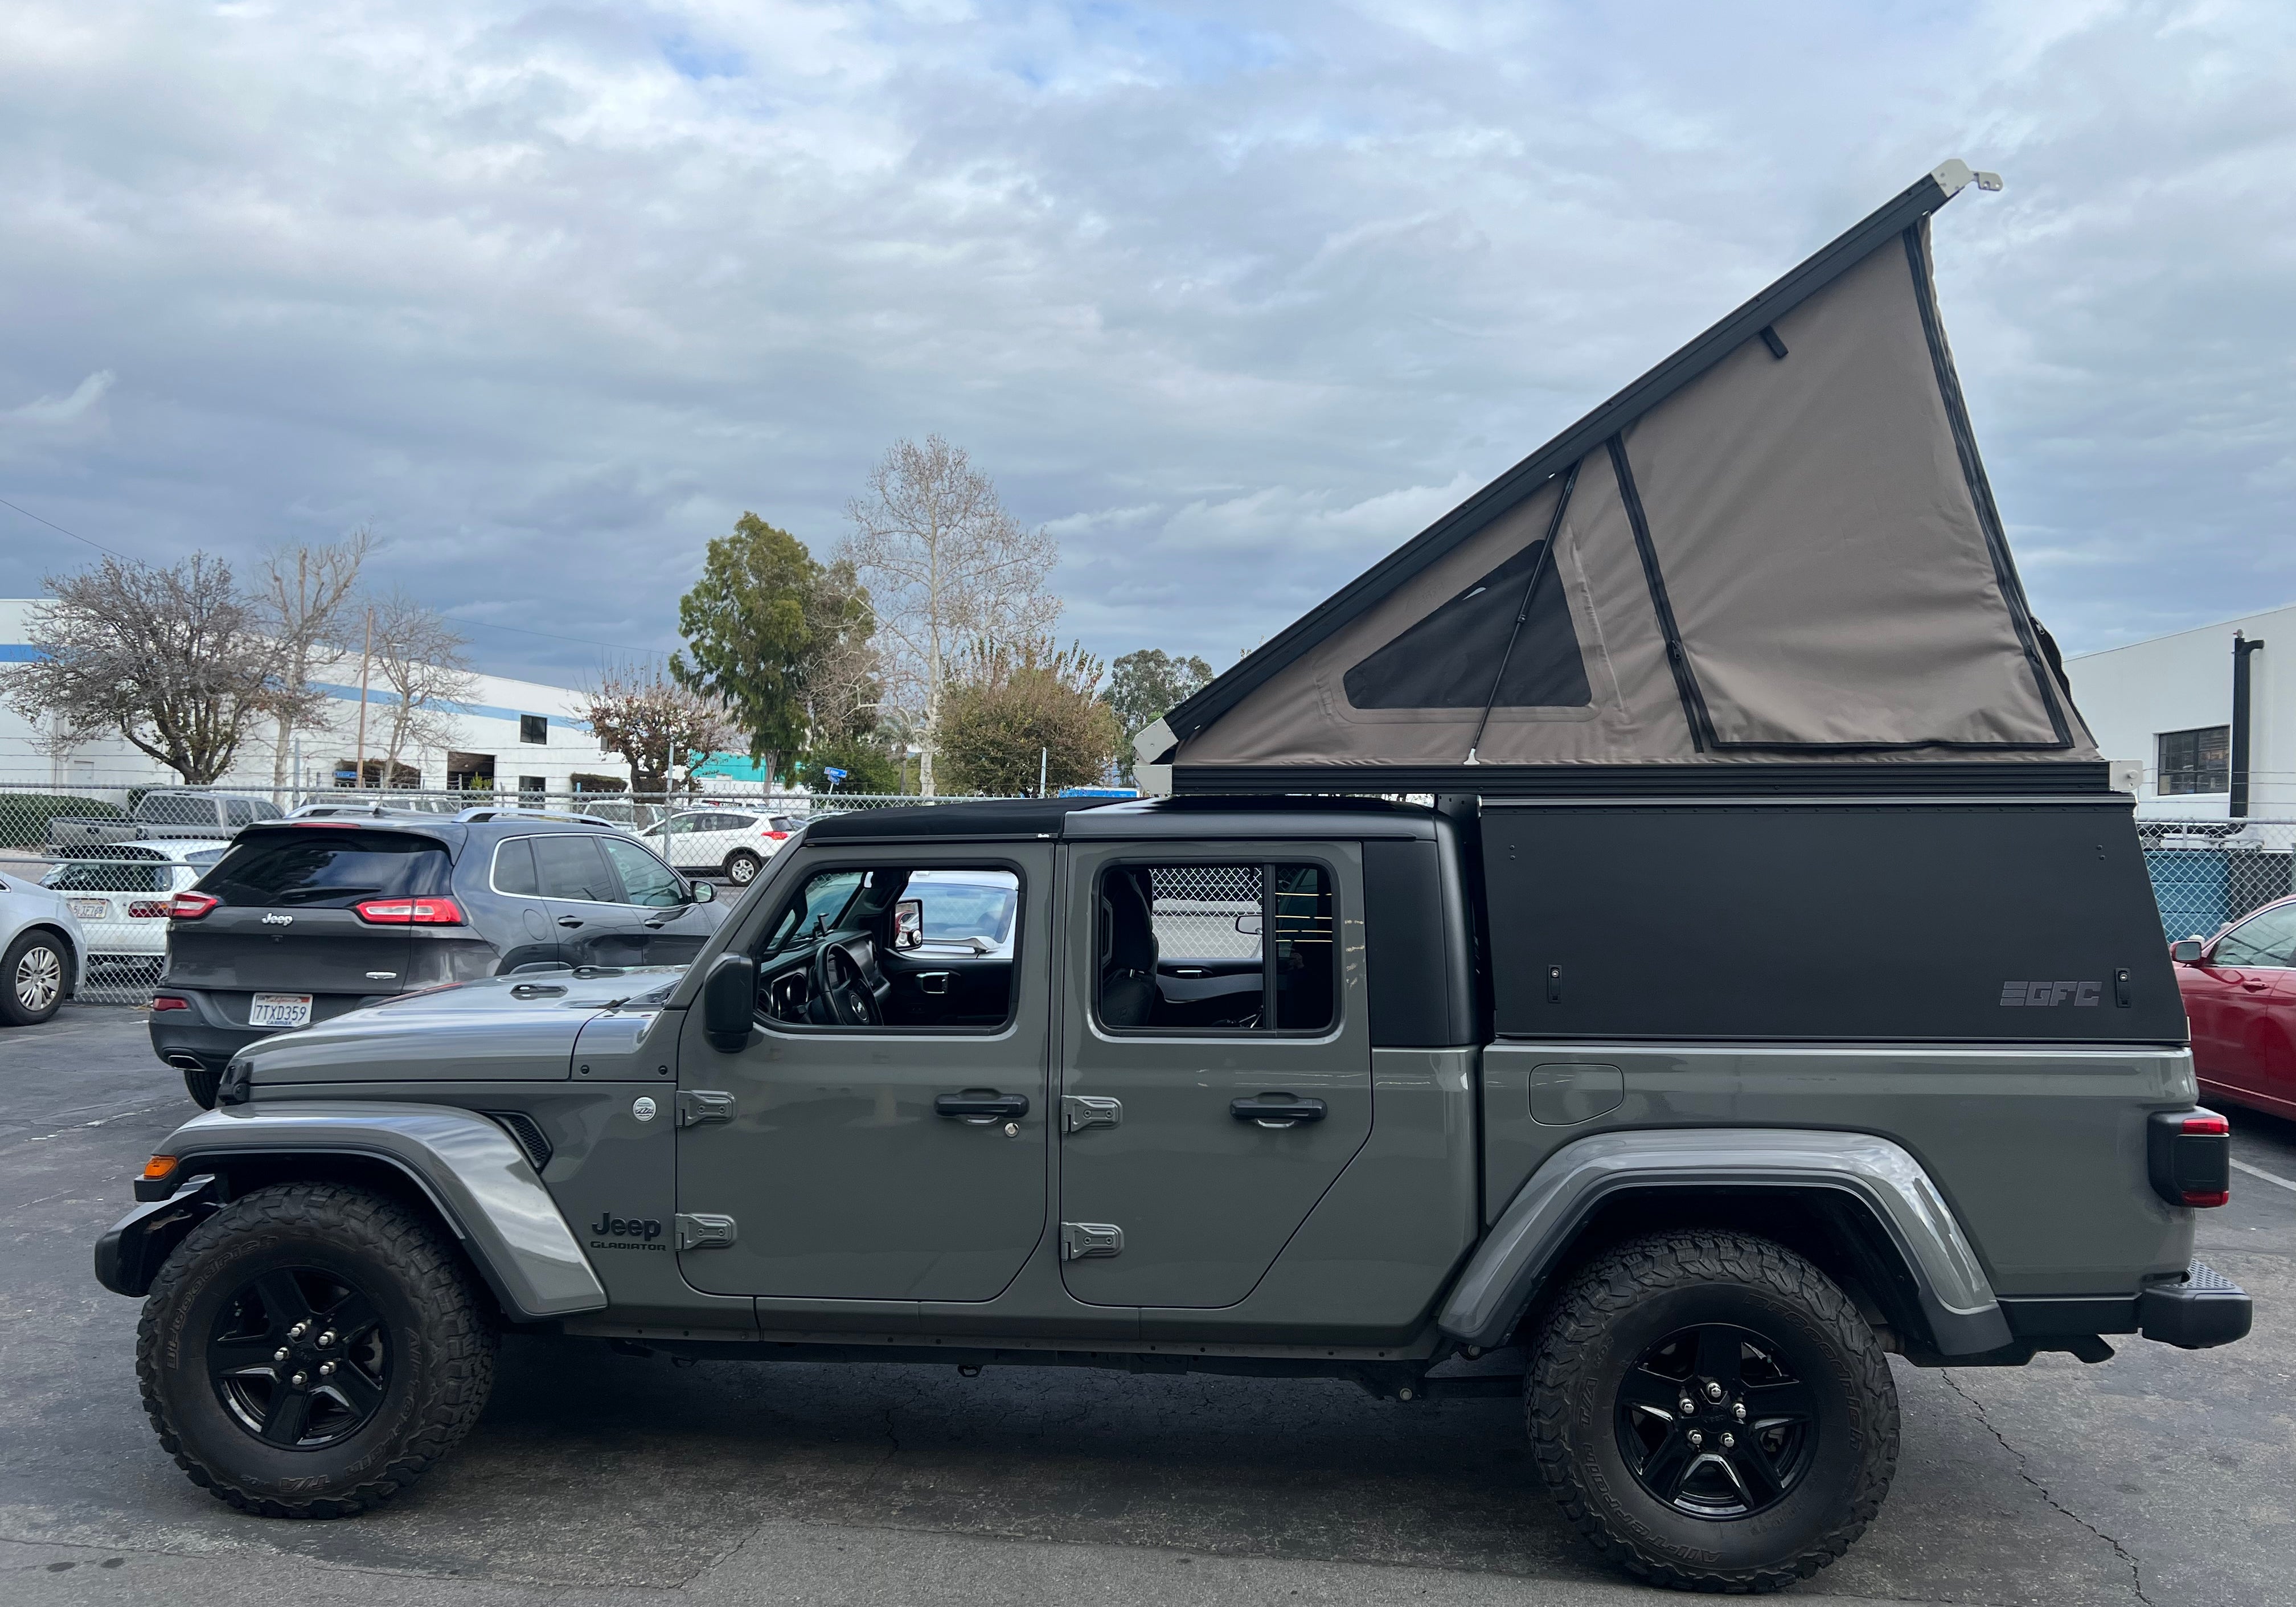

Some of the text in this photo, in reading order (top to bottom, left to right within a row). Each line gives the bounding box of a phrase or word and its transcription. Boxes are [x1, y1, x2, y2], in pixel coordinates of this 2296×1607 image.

[261, 912, 293, 926] Jeep
[2024, 981, 2102, 1006] GFC
[256, 1005, 306, 1021] 7TXD359
[592, 1211, 661, 1241] Jeep
[590, 1241, 666, 1251] GLADIATOR
[1578, 1377, 1598, 1428] T/A
